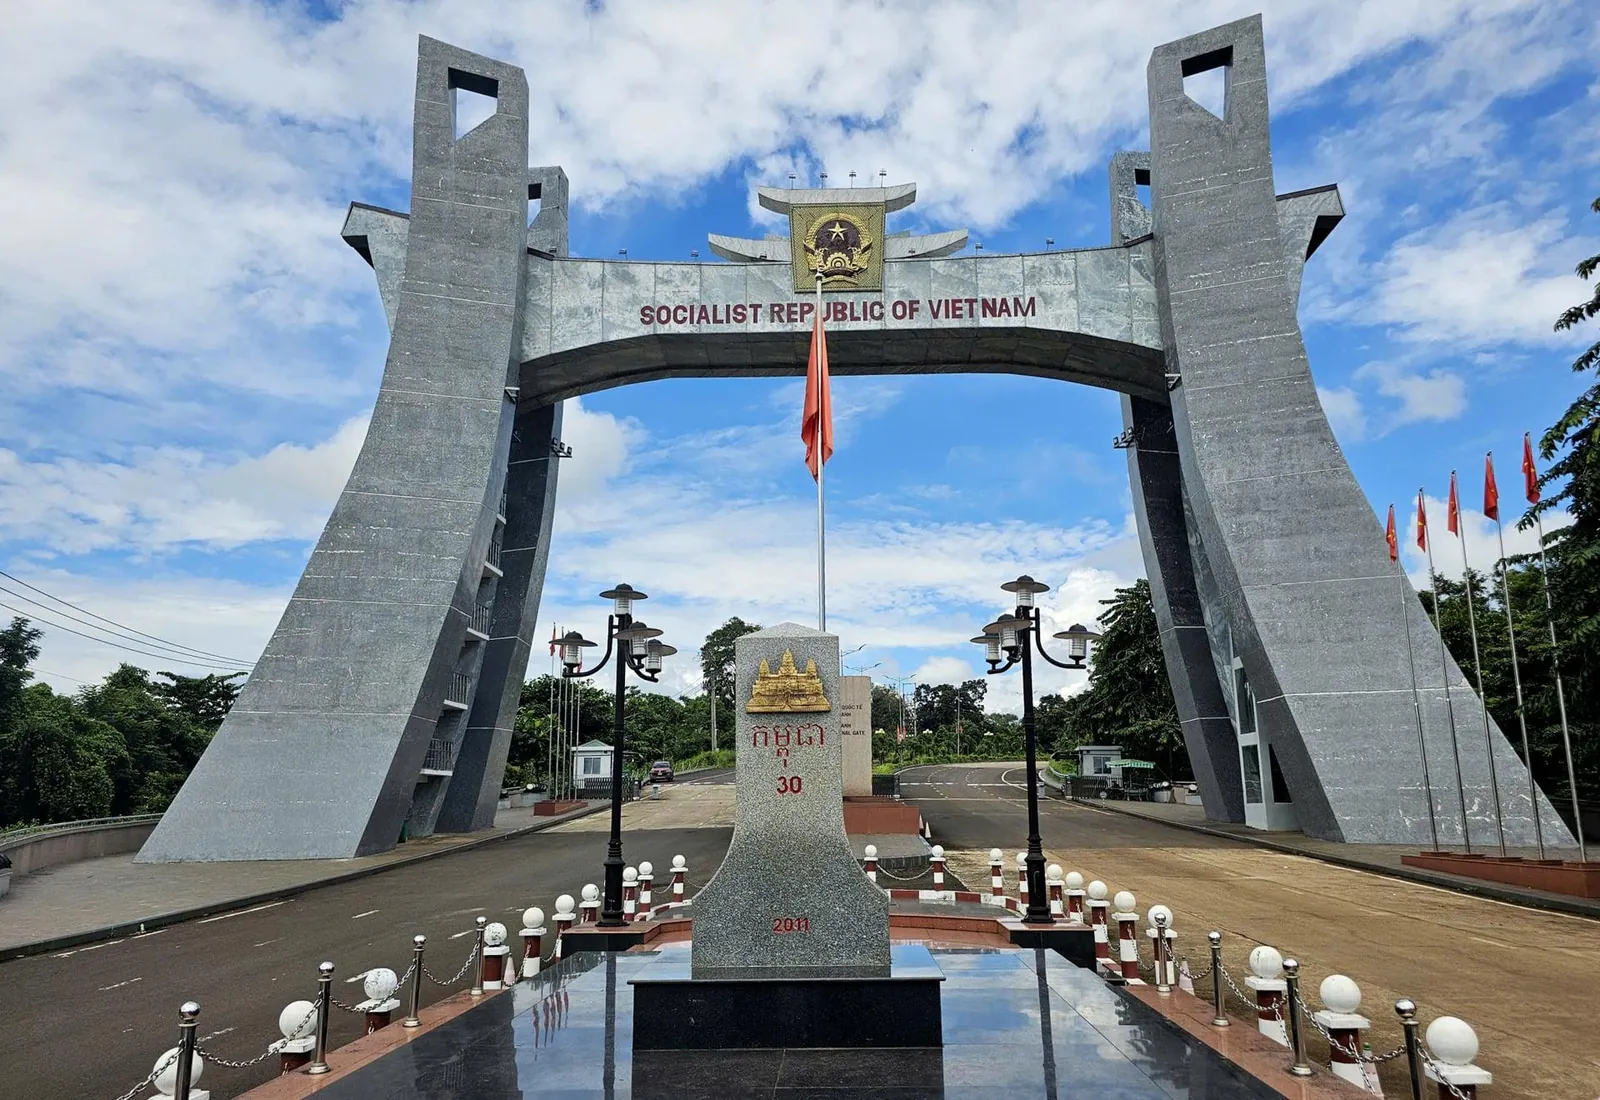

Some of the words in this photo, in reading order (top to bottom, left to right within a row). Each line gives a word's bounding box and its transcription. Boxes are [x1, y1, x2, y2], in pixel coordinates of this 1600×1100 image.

[640, 304, 763, 325] SOCIALIST
[769, 301, 885, 323] REPUBLIC
[892, 300, 920, 320] OF
[776, 775, 802, 795] 30
[773, 917, 810, 933] 2011
